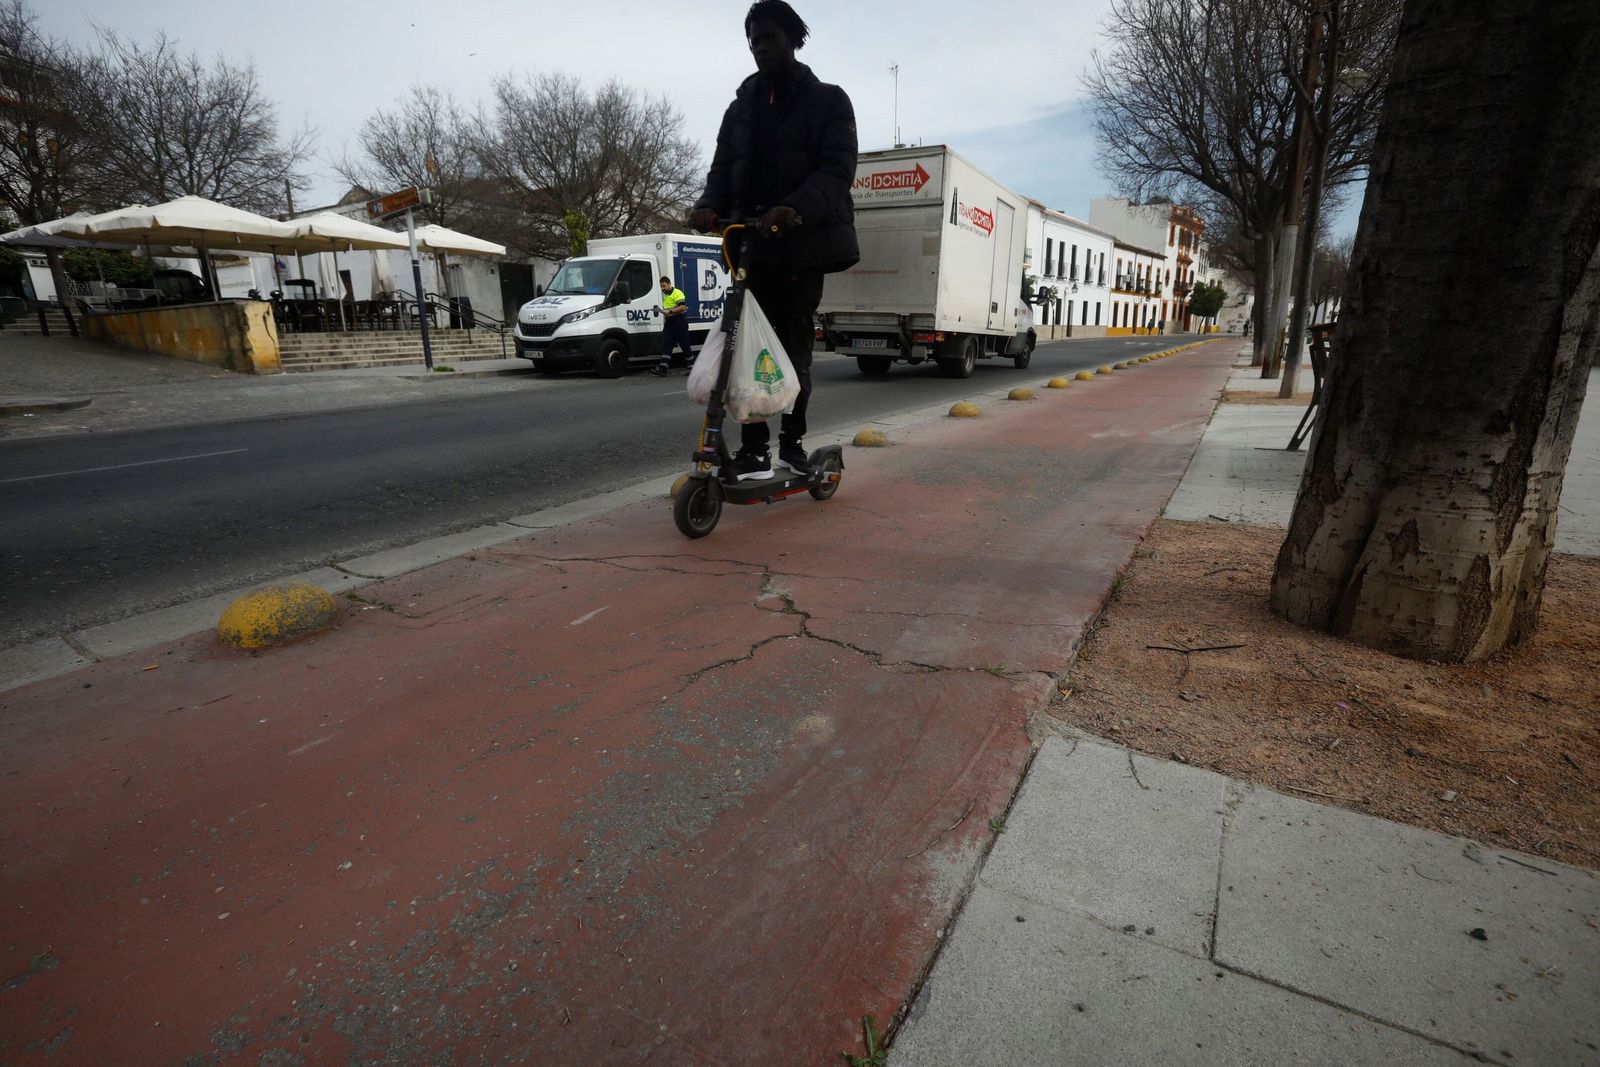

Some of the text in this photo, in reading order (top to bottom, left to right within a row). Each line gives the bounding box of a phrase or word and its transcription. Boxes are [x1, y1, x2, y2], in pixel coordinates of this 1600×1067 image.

[850, 176, 871, 190] ANS
[875, 190, 913, 198] Transportes
[626, 309, 651, 321] DIAZ
